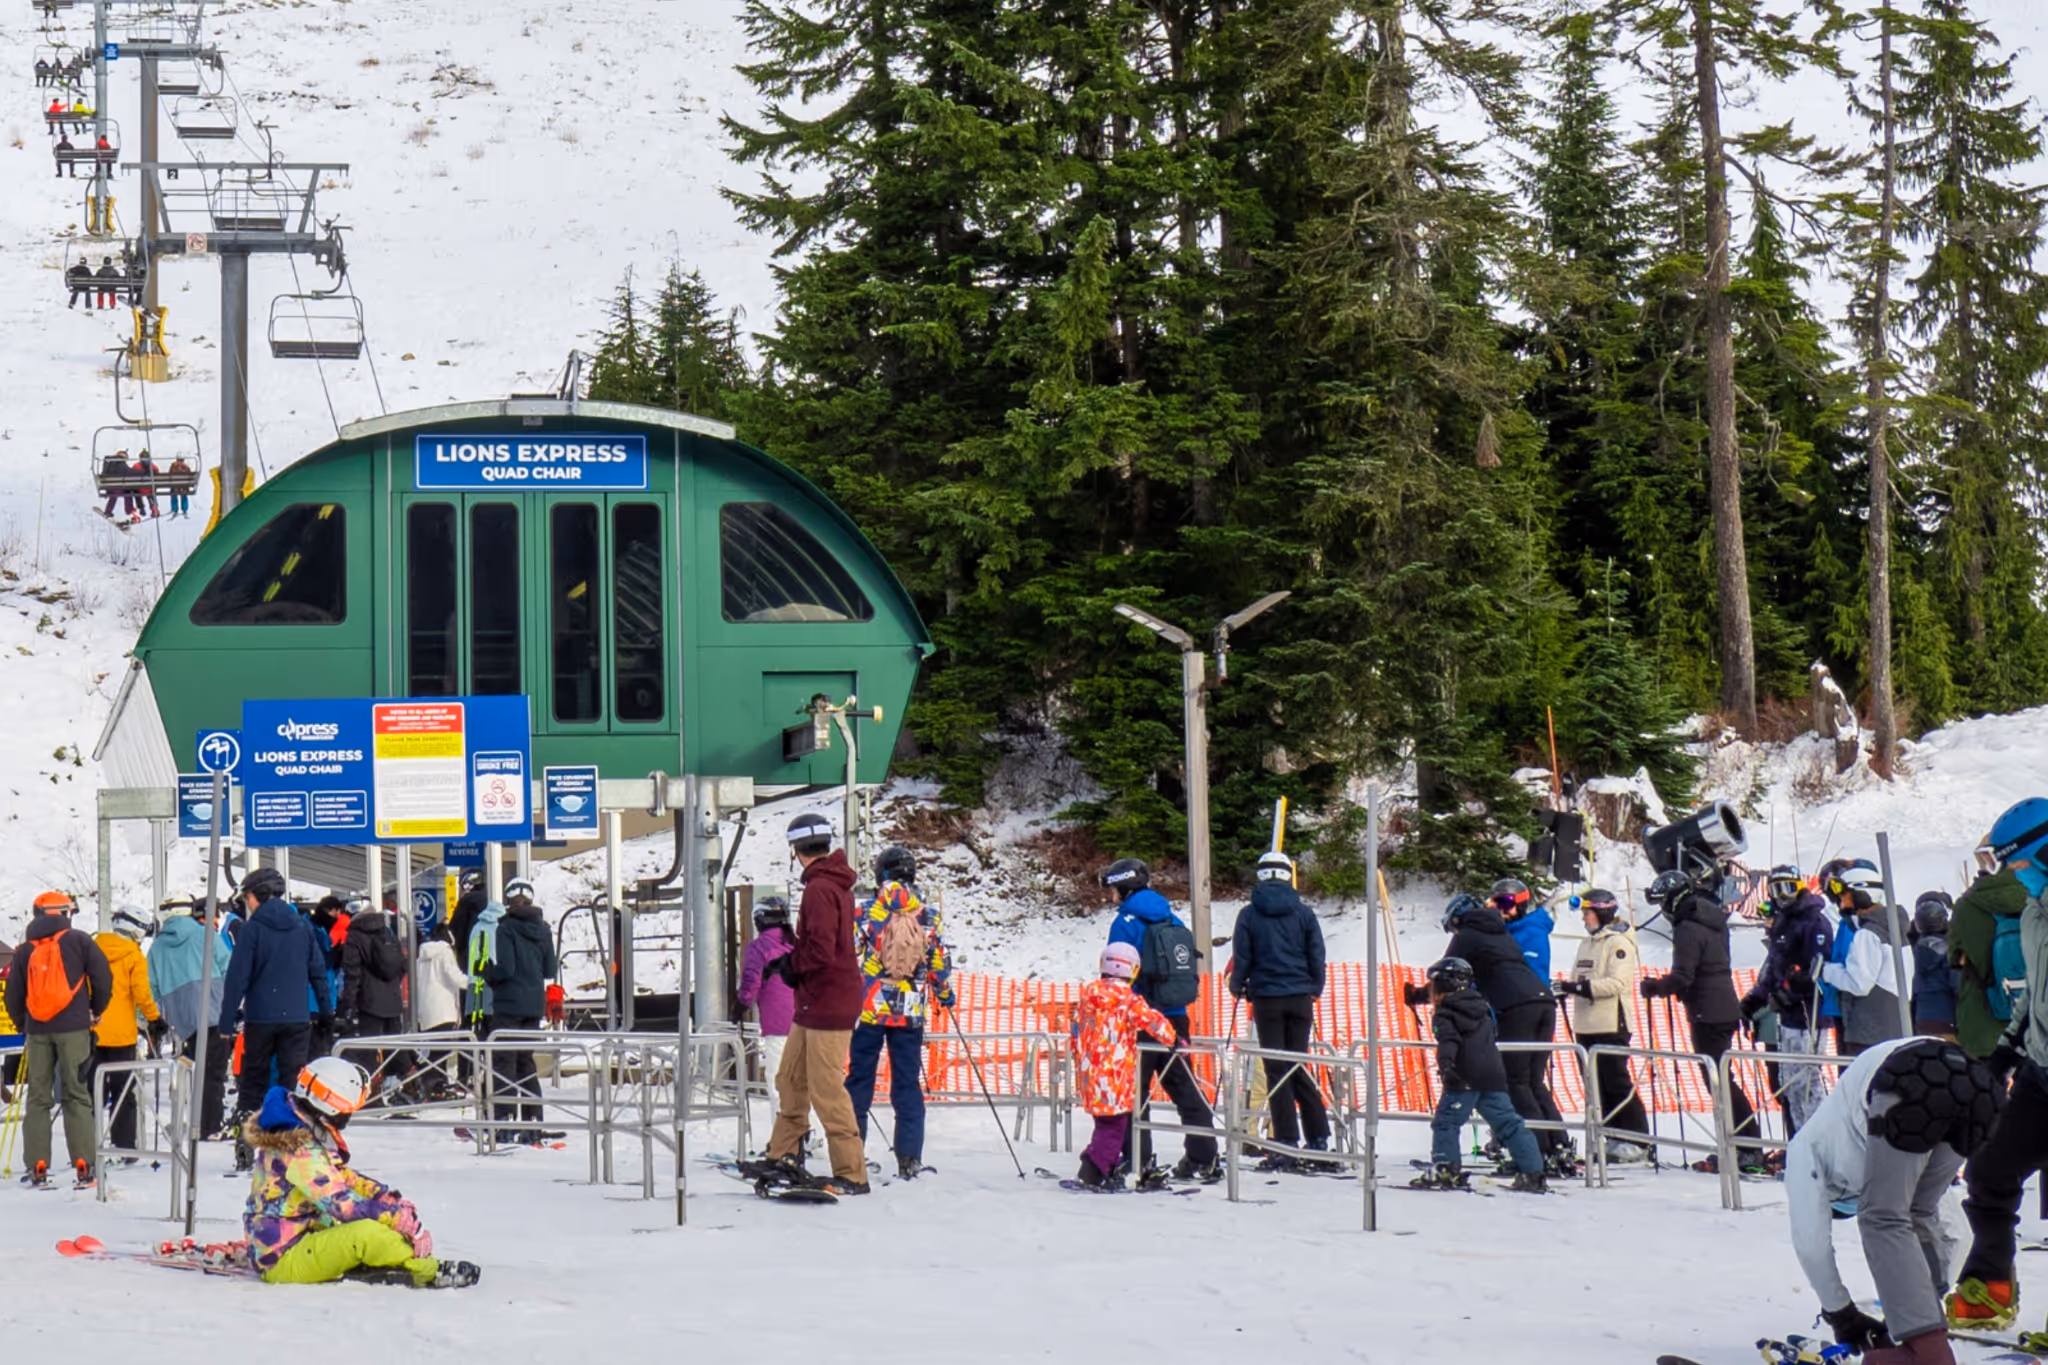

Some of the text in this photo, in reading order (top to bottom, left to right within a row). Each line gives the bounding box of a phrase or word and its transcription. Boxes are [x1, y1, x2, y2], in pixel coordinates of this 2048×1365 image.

[436, 444, 627, 463] LIONS EXPRESS
[481, 466, 582, 481] QUAD CHAIR
[254, 750, 364, 763] LIONS EXPRESS
[275, 764, 343, 776] QUAD CHAIR
